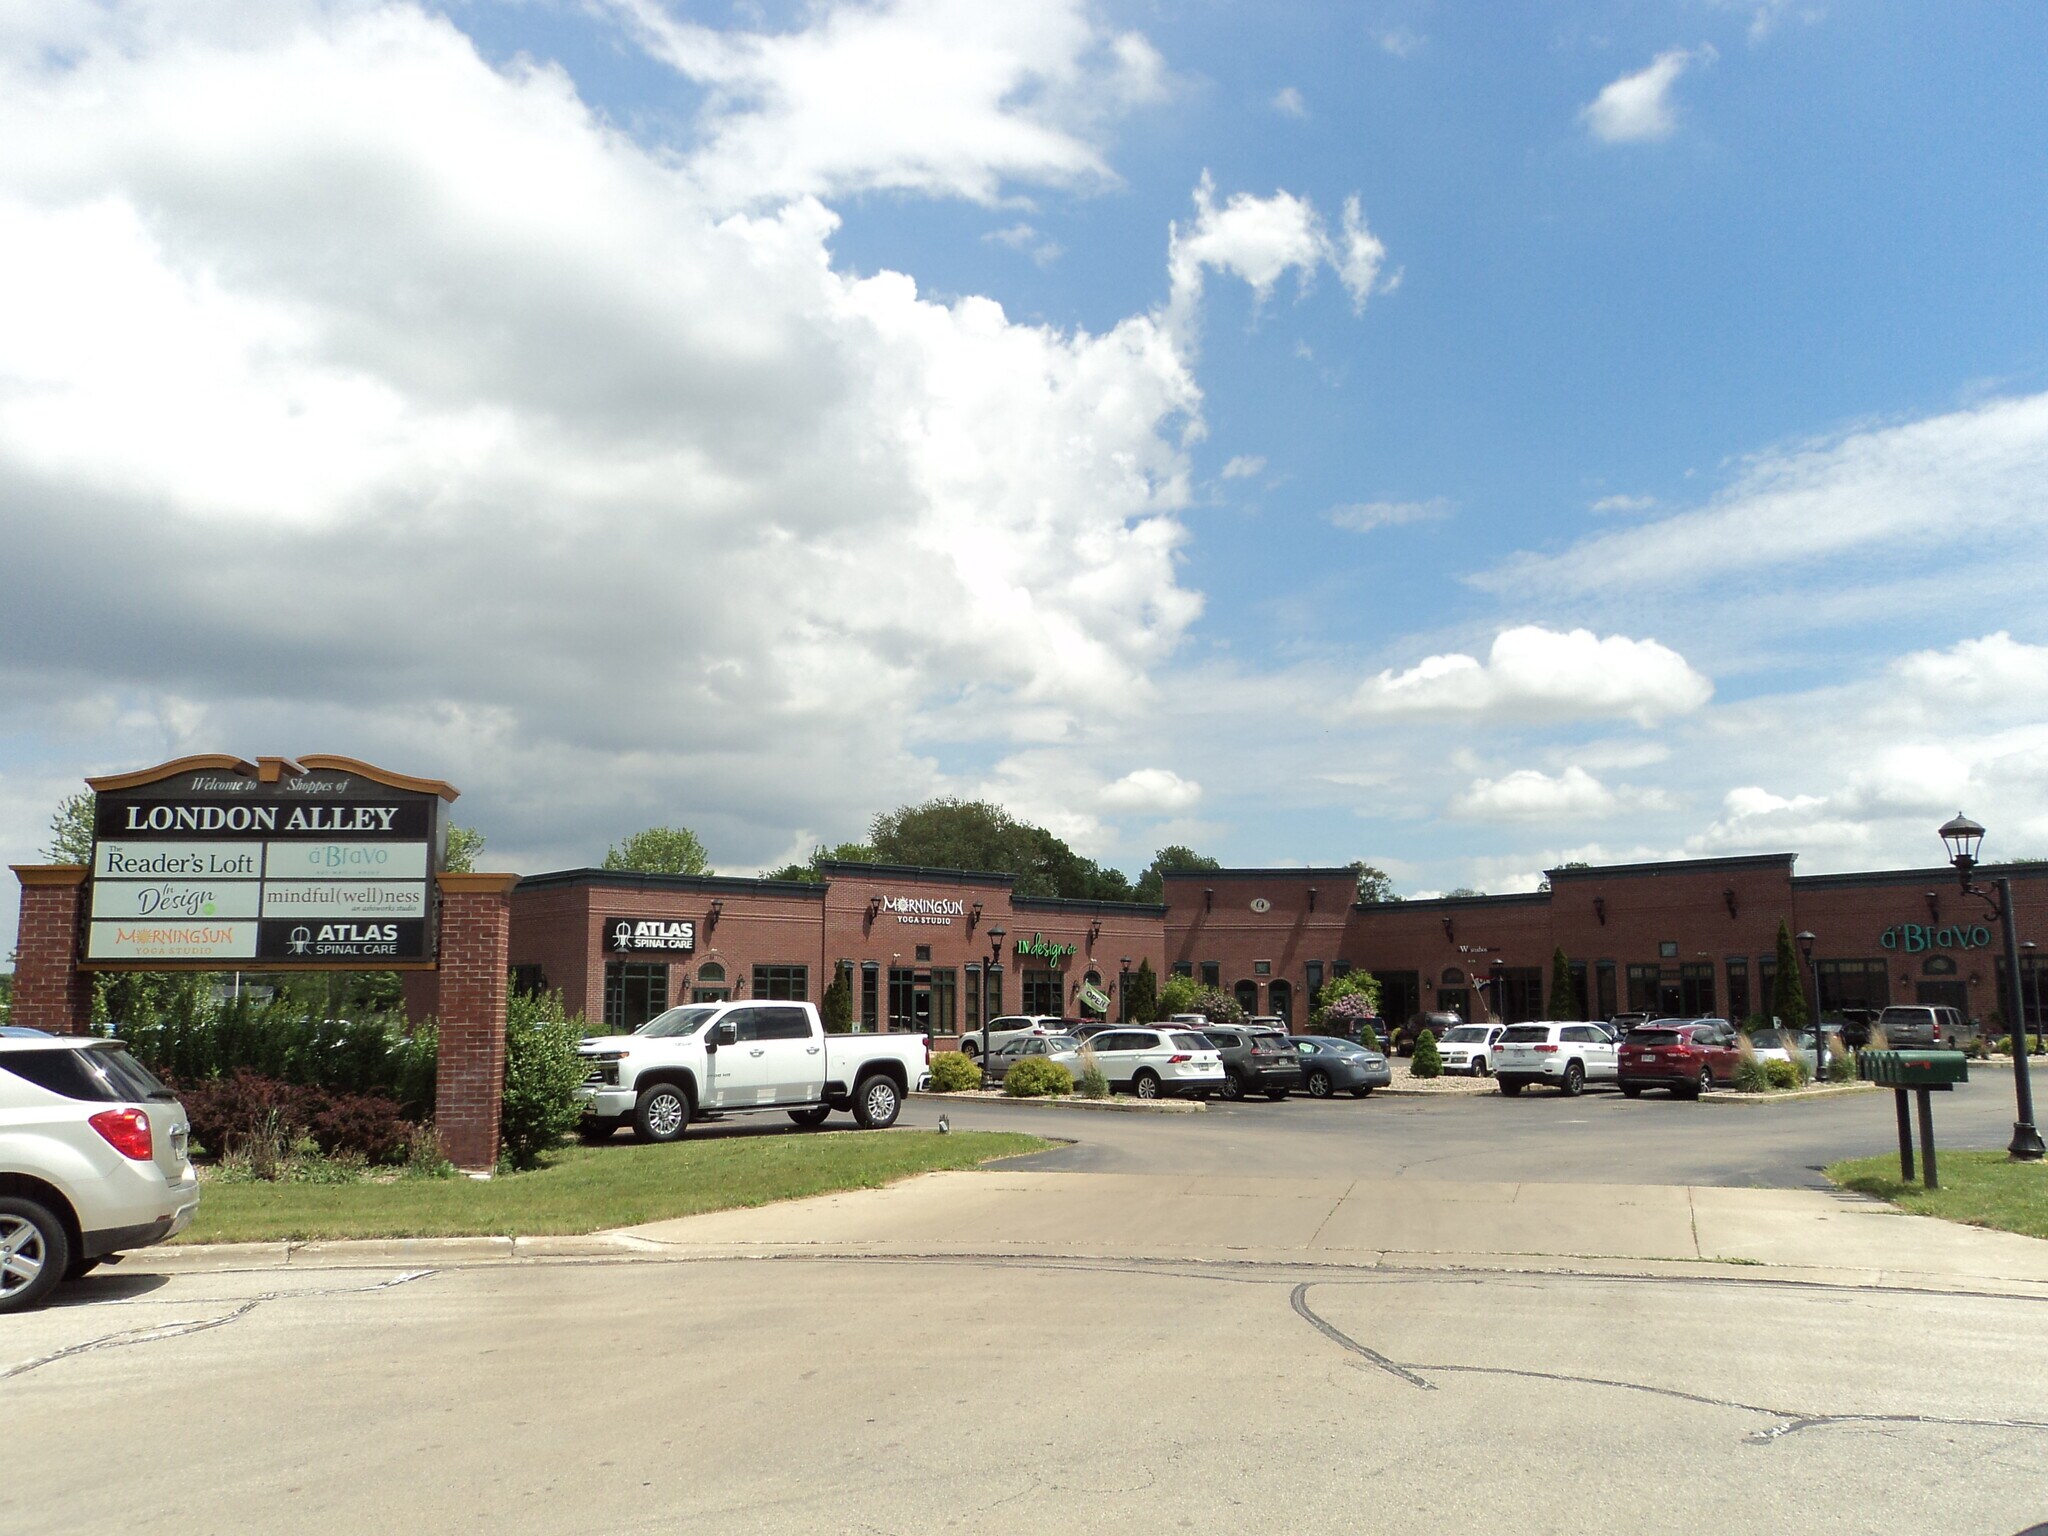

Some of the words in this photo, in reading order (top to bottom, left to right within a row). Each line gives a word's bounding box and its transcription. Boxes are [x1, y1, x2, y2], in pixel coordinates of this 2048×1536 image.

[191, 777, 243, 791] Welcome
[246, 780, 257, 791] to
[286, 778, 332, 794] Shoppes
[336, 778, 349, 793] of
[125, 806, 279, 831] LONDON
[285, 807, 399, 831] ALLEY
[107, 853, 203, 873] Reader's
[209, 854, 254, 873] Loft
[162, 883, 174, 896] In
[267, 887, 420, 905] mindful(well)ness
[138, 887, 216, 915] Design
[396, 904, 417, 912] studio
[897, 915, 920, 924] YOGA
[921, 916, 951, 925] STUDIO
[316, 924, 398, 941] ATLAS
[634, 921, 693, 938] ATLAS
[136, 947, 165, 955] YOGA
[169, 947, 212, 955] STUDIO
[316, 944, 360, 955] SPINAL
[363, 944, 397, 955] CARE
[634, 938, 667, 948] SPINAL
[668, 939, 693, 949] CARE
[1017, 940, 1030, 954] IN
[1030, 932, 1066, 969] design
